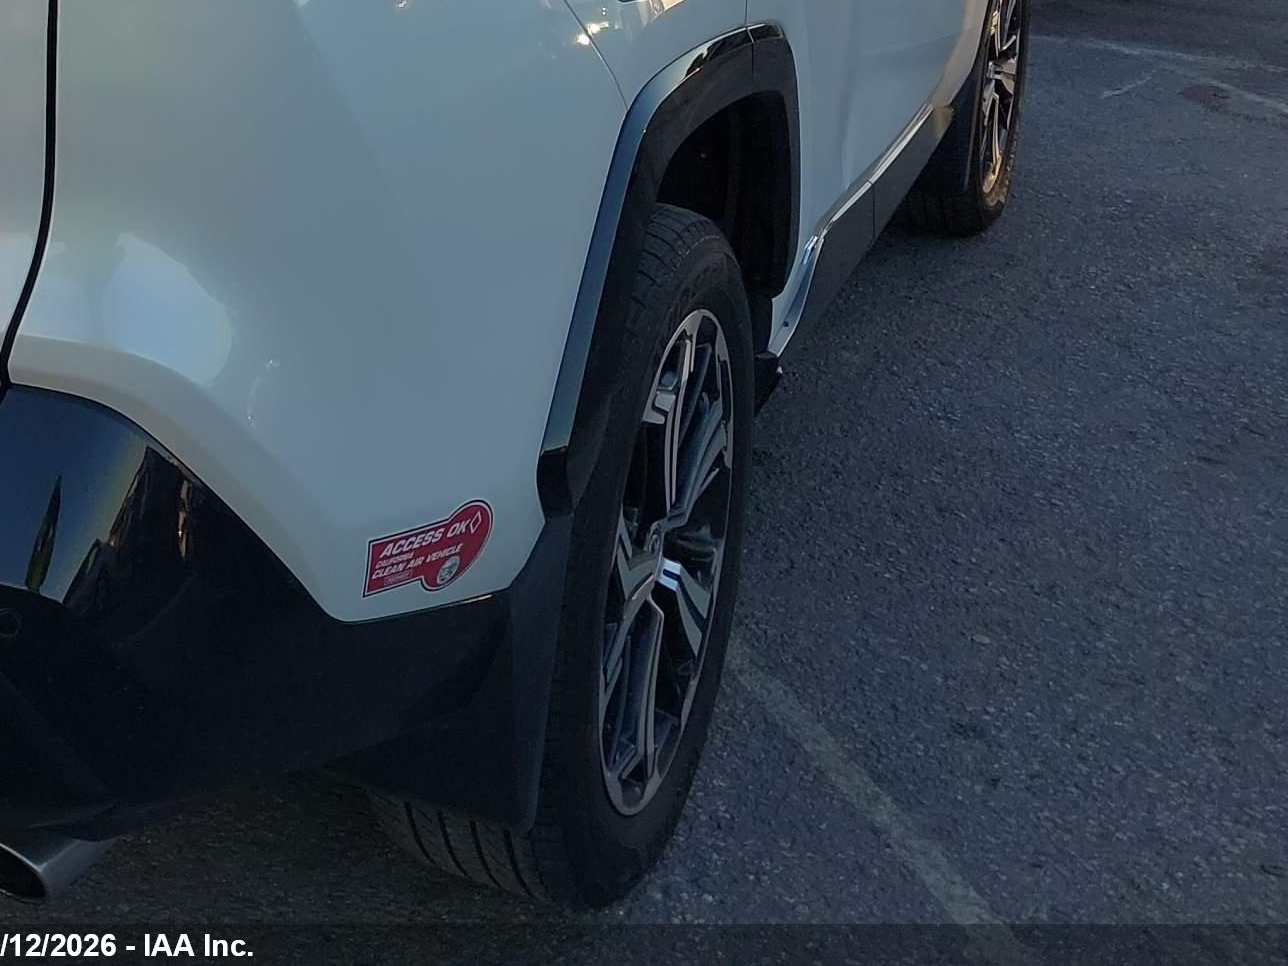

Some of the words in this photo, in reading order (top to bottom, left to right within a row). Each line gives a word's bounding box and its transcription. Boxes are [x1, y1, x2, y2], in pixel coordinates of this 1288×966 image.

[380, 528, 445, 558] ACCESS
[447, 518, 471, 538] OK
[372, 564, 408, 580] CLEAN
[408, 556, 425, 570] AIR
[426, 543, 463, 563] VEHICLE
